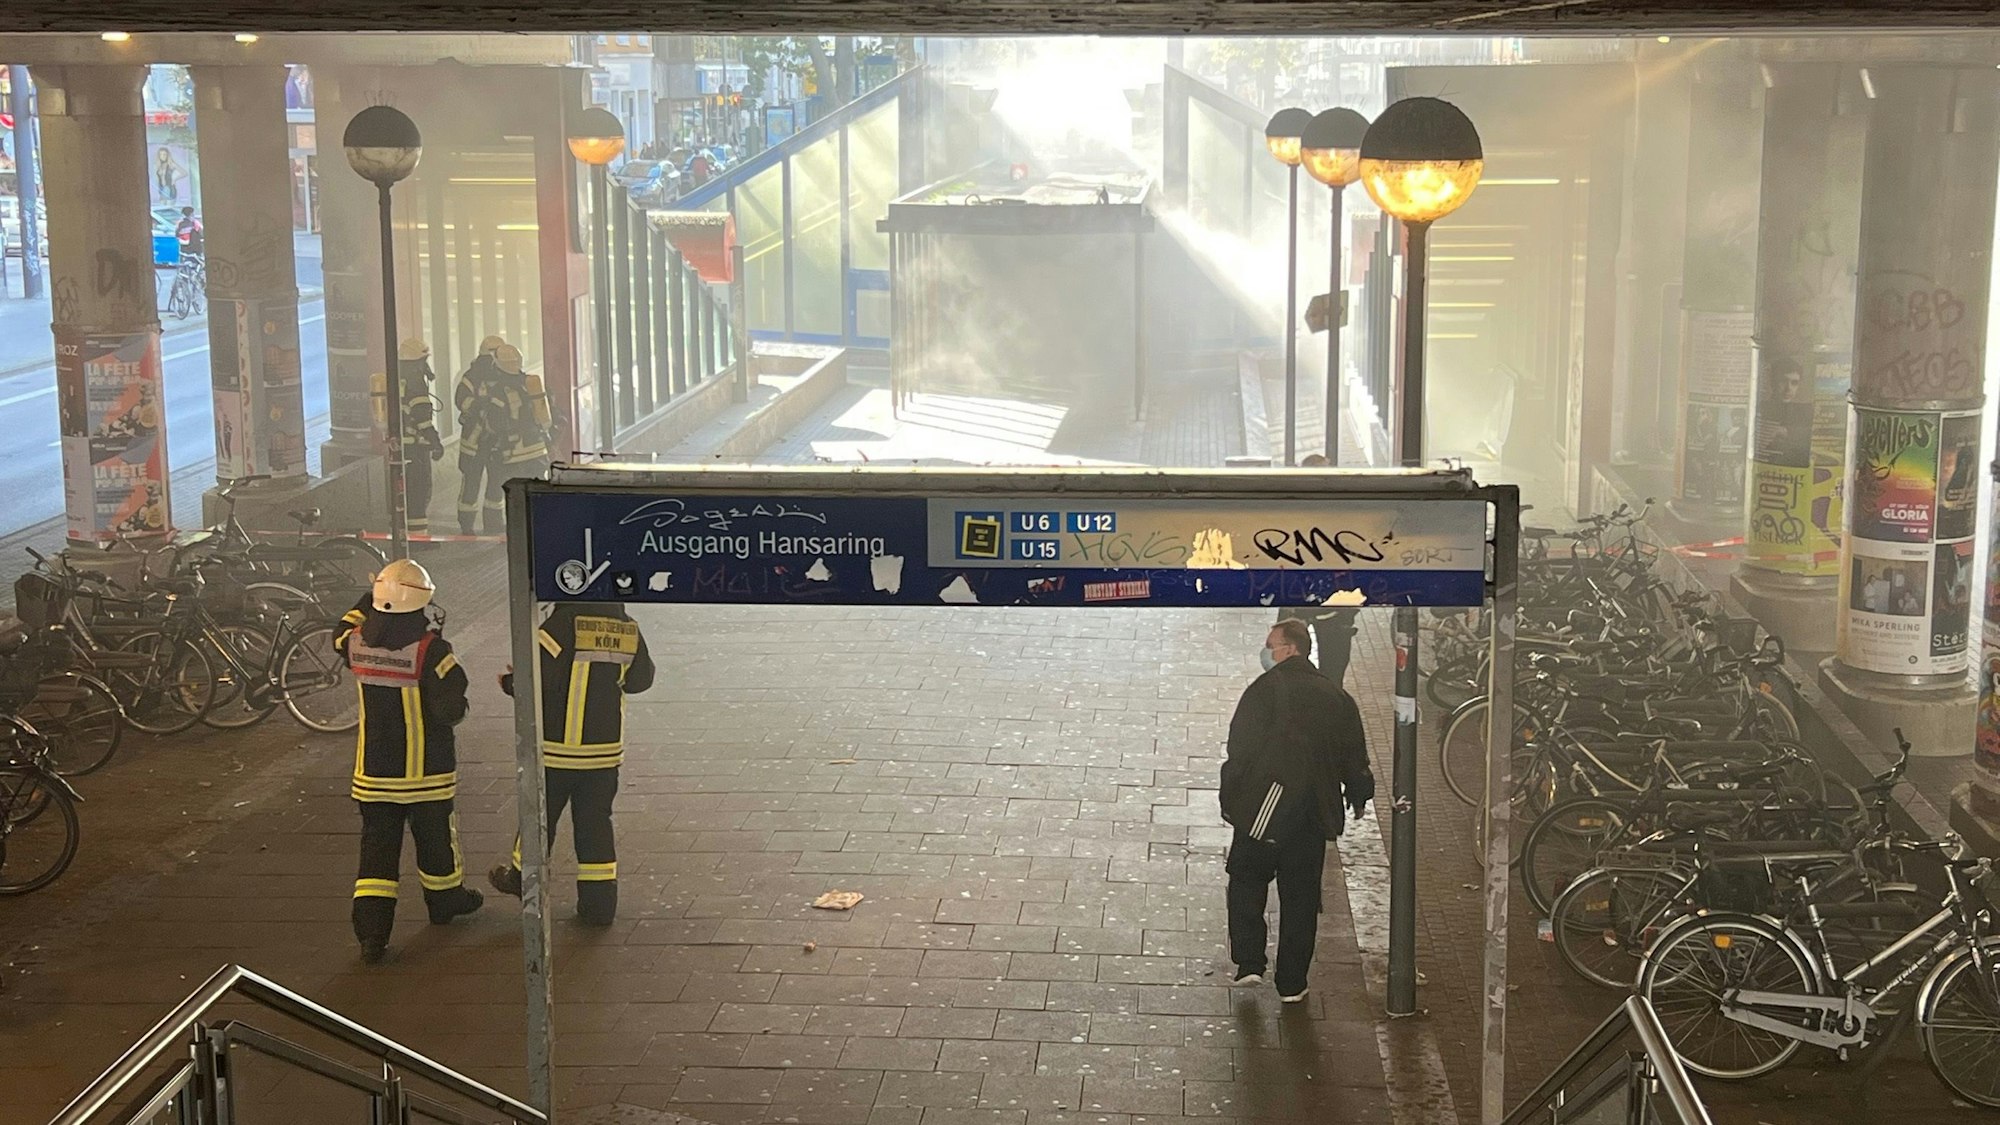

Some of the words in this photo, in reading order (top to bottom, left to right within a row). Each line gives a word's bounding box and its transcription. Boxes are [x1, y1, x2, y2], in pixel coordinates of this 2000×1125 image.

[1881, 508, 1929, 520] GLORIA
[1021, 515, 1033, 530] U
[1038, 515, 1050, 530] 6
[1076, 515, 1089, 531] U
[1093, 515, 1112, 531] 12
[641, 530, 750, 559] Ausgang
[759, 531, 885, 558] Hansaring
[1021, 542, 1033, 557] U
[1038, 542, 1056, 558] 15
[1873, 621, 1921, 632] SPERLING
[595, 634, 621, 649] KÖLN
